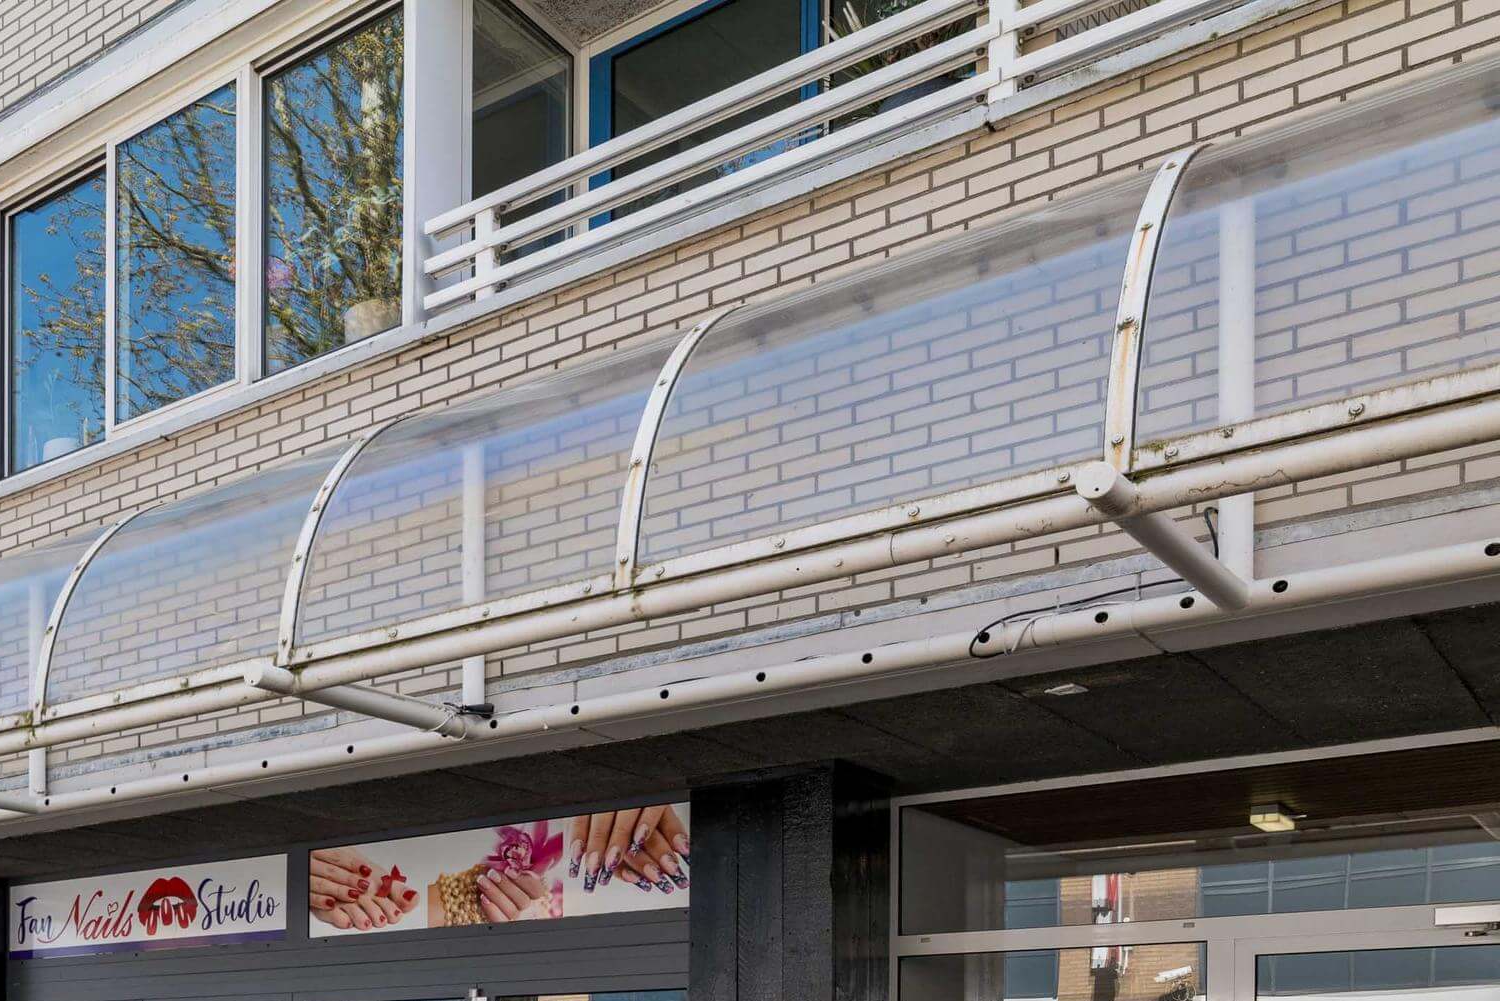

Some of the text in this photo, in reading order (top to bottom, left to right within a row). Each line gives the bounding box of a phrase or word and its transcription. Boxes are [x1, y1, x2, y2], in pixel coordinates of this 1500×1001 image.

[15, 878, 281, 944] Fan Nails Studio
